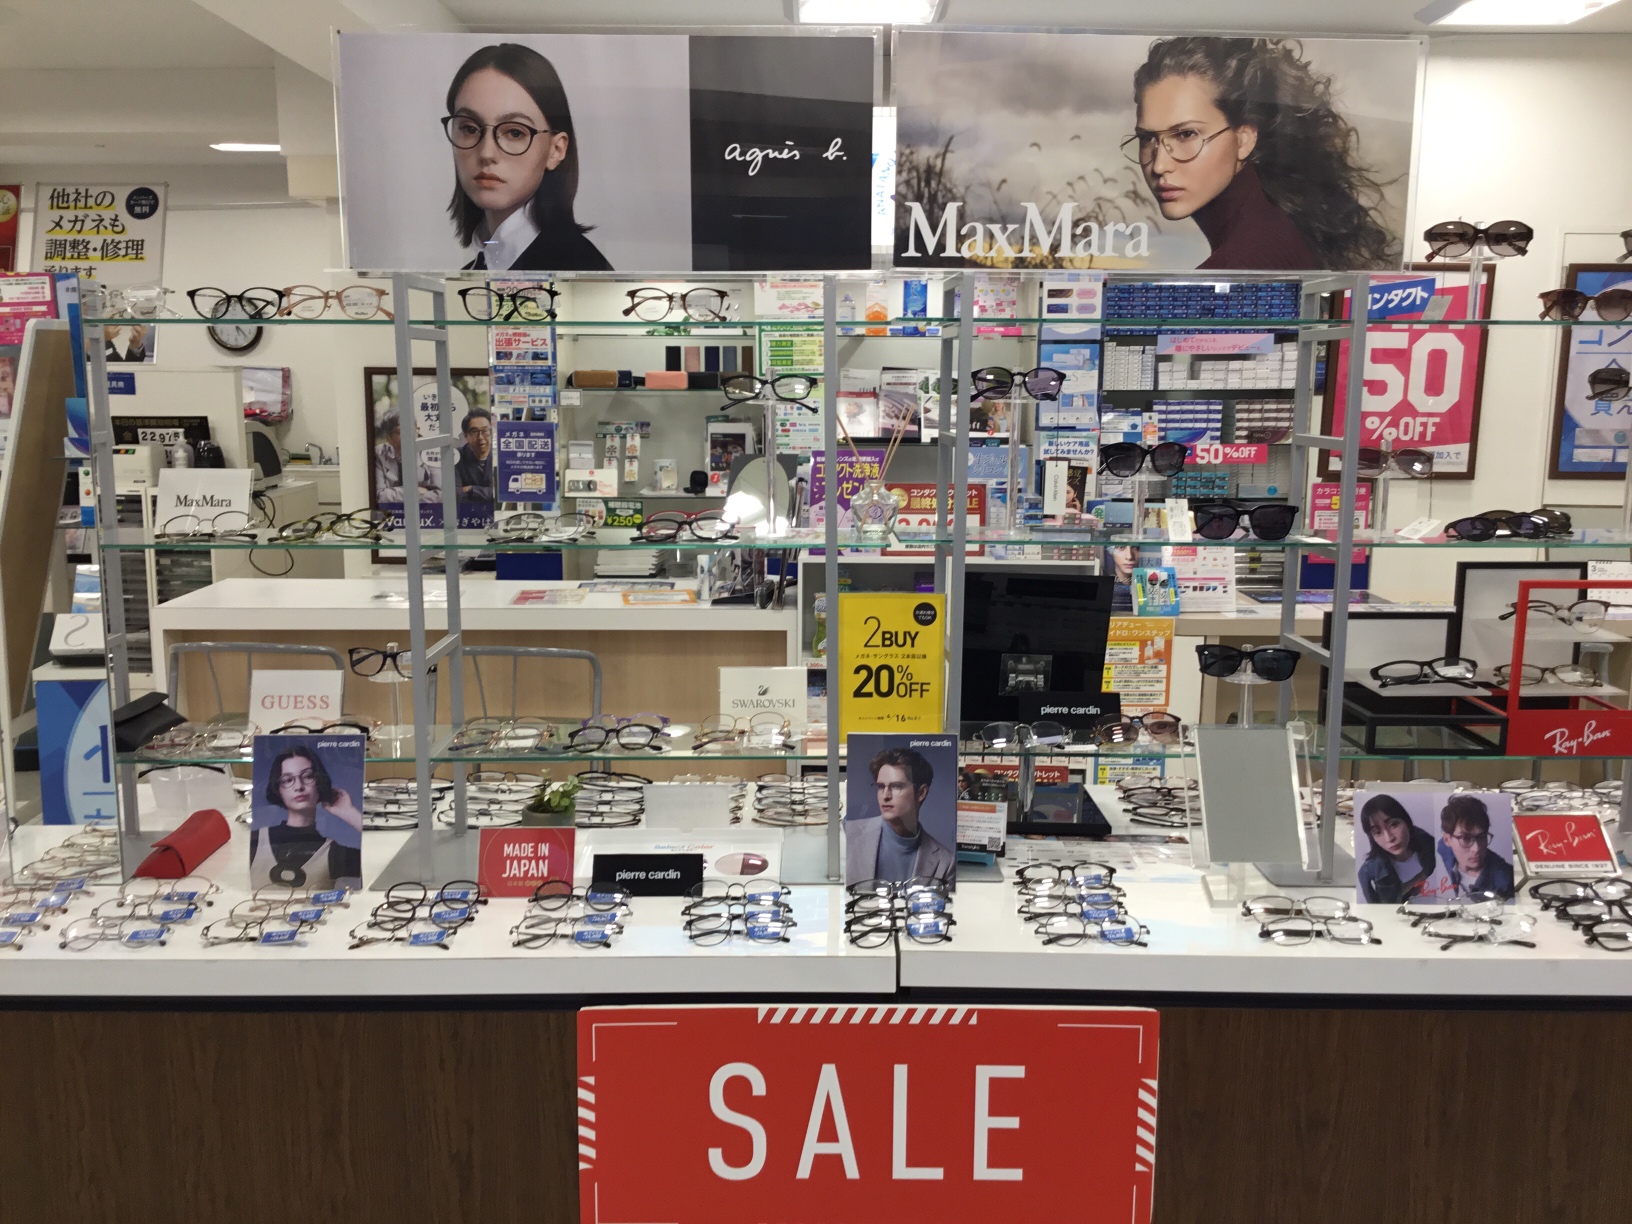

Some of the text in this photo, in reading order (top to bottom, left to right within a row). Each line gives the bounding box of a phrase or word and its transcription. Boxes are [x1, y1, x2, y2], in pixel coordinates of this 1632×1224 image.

[724, 140, 800, 176] agnès
[48, 187, 116, 211] 他社の
[45, 213, 126, 235] メガネも
[901, 201, 1149, 258] MaxMara
[44, 239, 146, 260] 調整・修理
[1367, 286, 1429, 310] ンタクト
[495, 337, 549, 346] 出張サービス
[1361, 332, 1464, 412] 50
[420, 402, 456, 411] 最初ら
[1364, 416, 1440, 441] %OFF
[501, 438, 551, 451] 全国配送
[1047, 440, 1091, 448] 新しいケア用品
[1043, 448, 1095, 456] 試してみませんか?
[910, 488, 978, 496] コンタクウット
[1316, 487, 1366, 495] カラコ便
[174, 494, 232, 508] MaxMara
[606, 515, 633, 526] ¥250
[896, 682, 931, 698] OFF
[261, 694, 330, 710] GUESS
[732, 699, 795, 708] SWAROVSKI
[1041, 705, 1101, 715] pierre cardin
[909, 739, 952, 747] pierre cardin
[1544, 720, 1611, 754] Ray-Ban
[317, 740, 360, 749] pierre cardin
[1525, 821, 1597, 855] Ray-Ban
[503, 843, 549, 857] MADE IN
[501, 859, 549, 878] JAPAN
[615, 869, 681, 881] pierre cardin
[707, 1062, 1026, 1181] SALE
